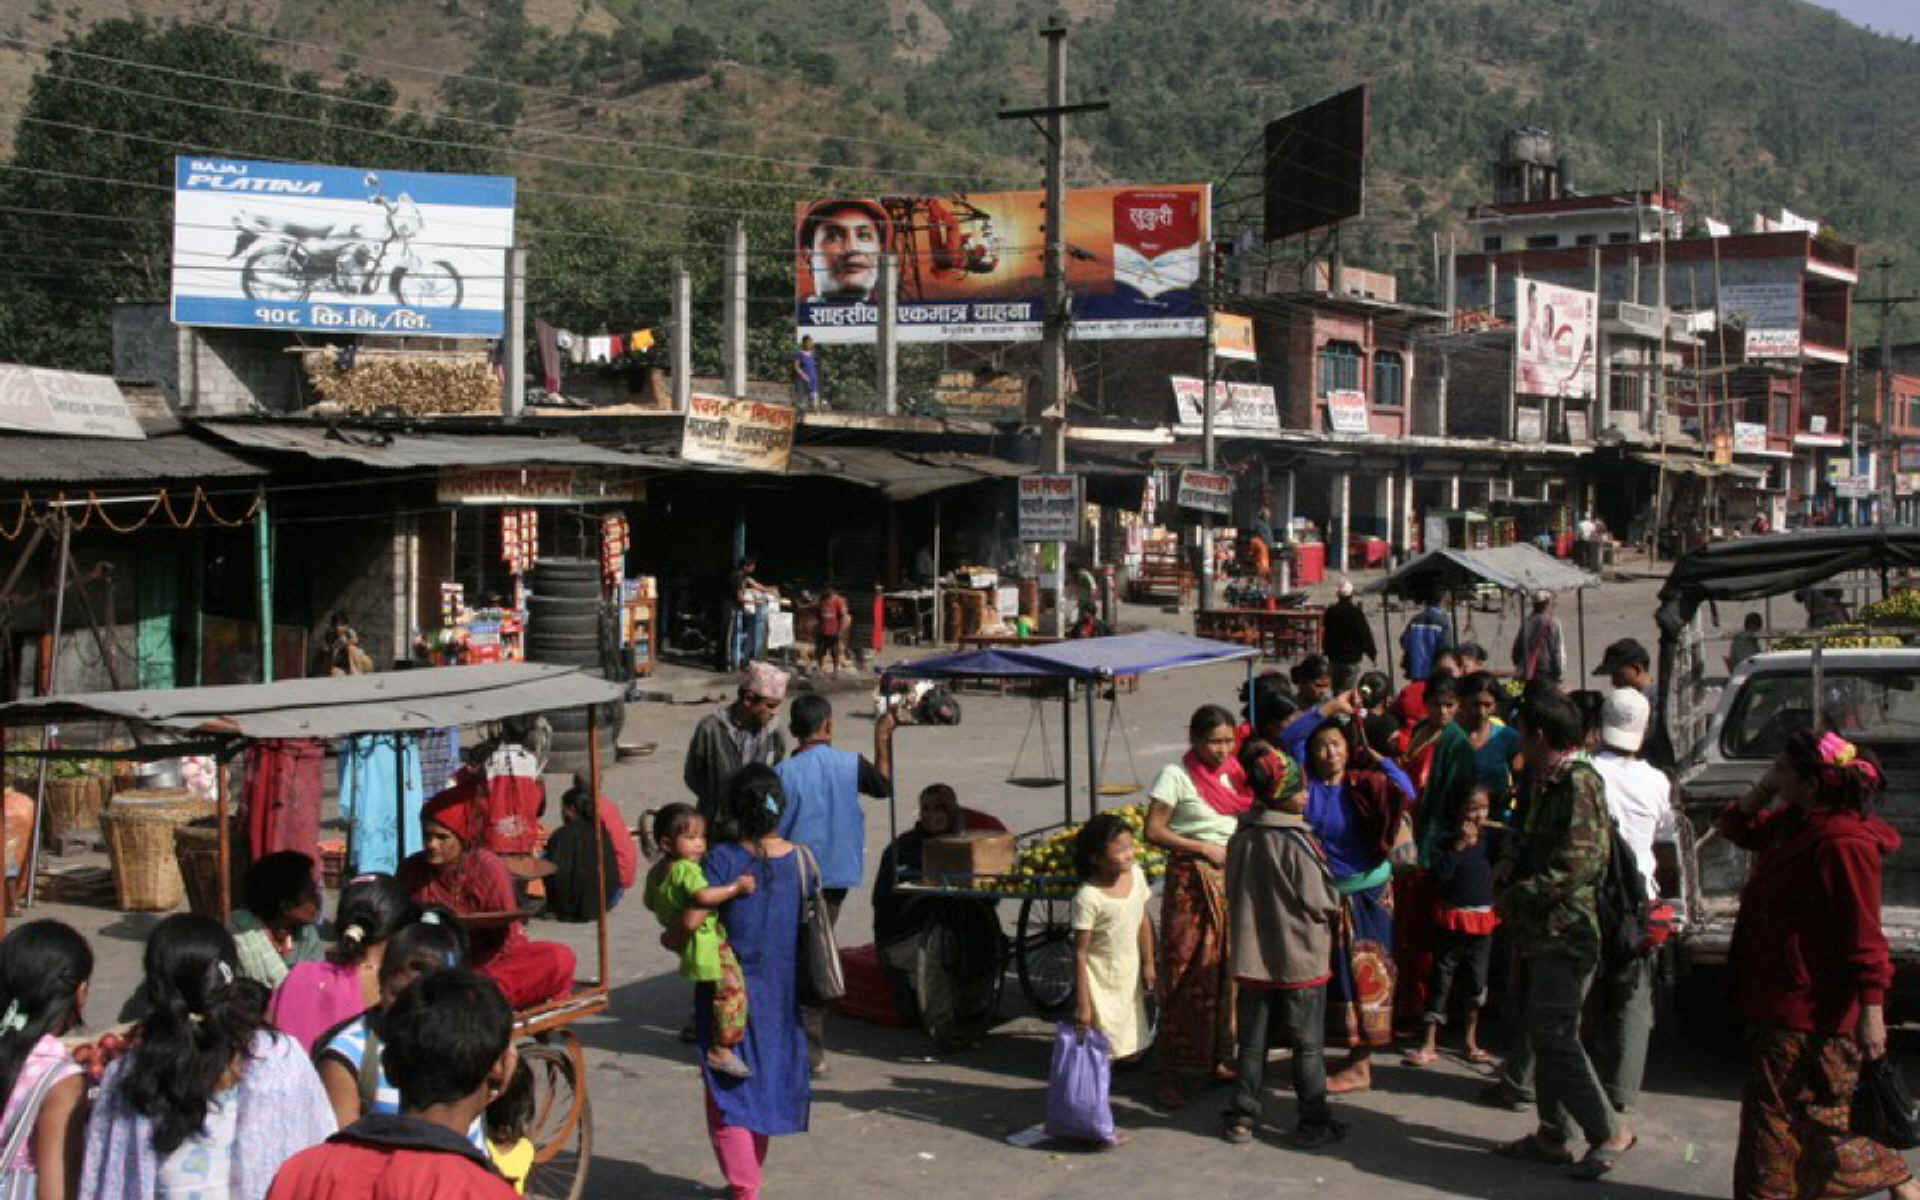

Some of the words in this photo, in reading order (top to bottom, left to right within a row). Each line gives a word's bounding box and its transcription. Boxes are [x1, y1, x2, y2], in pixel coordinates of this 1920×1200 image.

[191, 160, 248, 176] BAJAJ
[187, 174, 323, 194] PLATINA
[897, 304, 967, 323] एकमात्र
